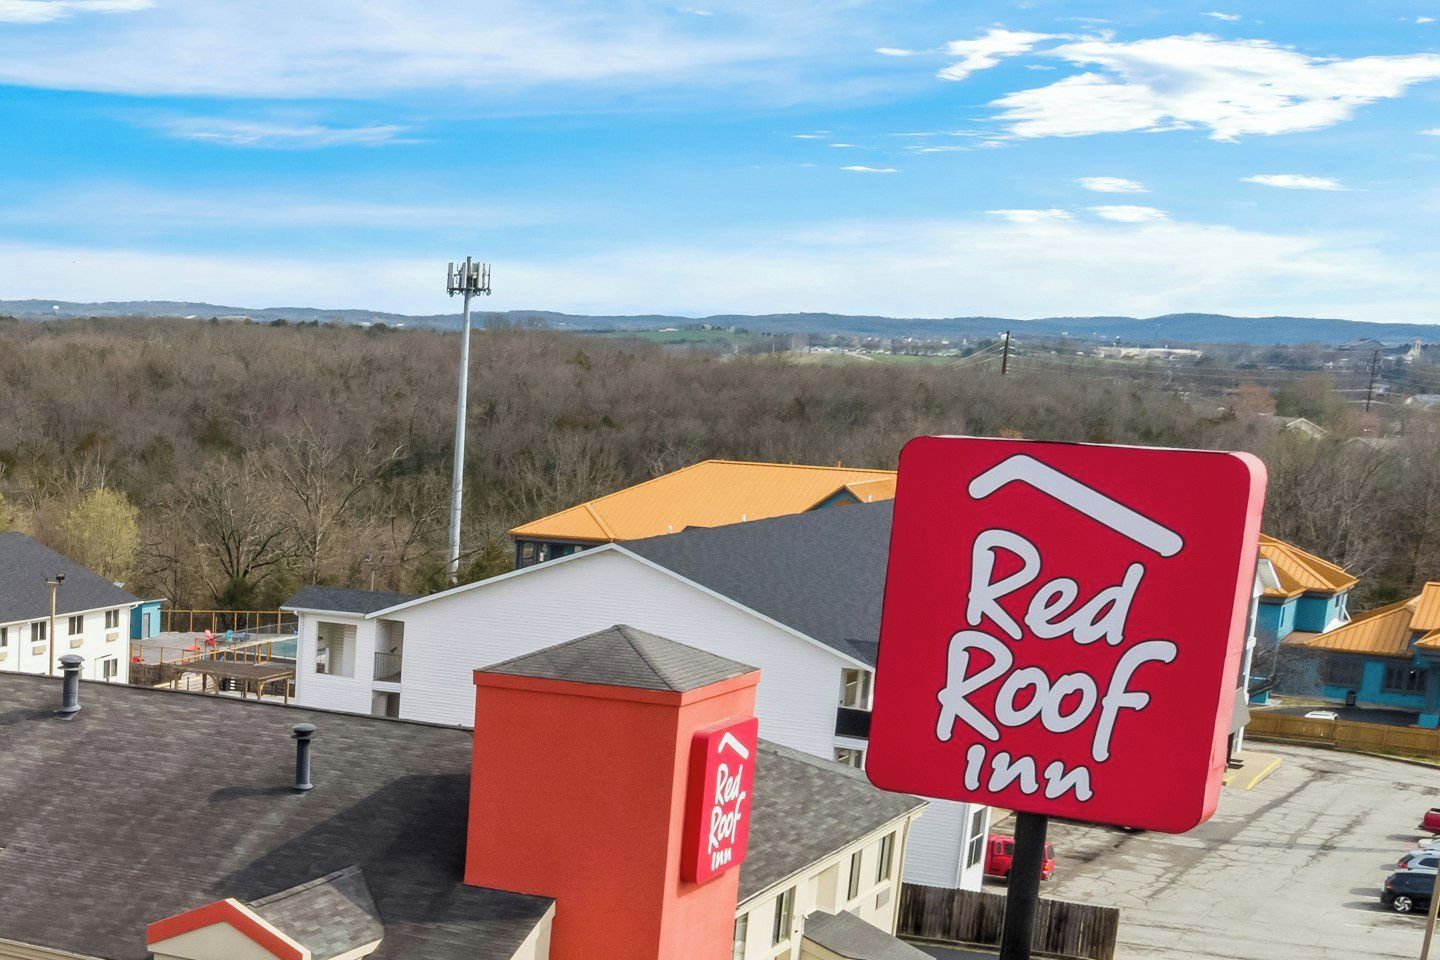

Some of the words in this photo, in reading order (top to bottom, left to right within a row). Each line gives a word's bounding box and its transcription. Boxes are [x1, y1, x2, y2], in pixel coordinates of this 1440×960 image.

[967, 529, 1145, 645] Red
[937, 630, 1177, 763] Roof
[707, 791, 746, 854] Roof
[715, 763, 743, 805] Red
